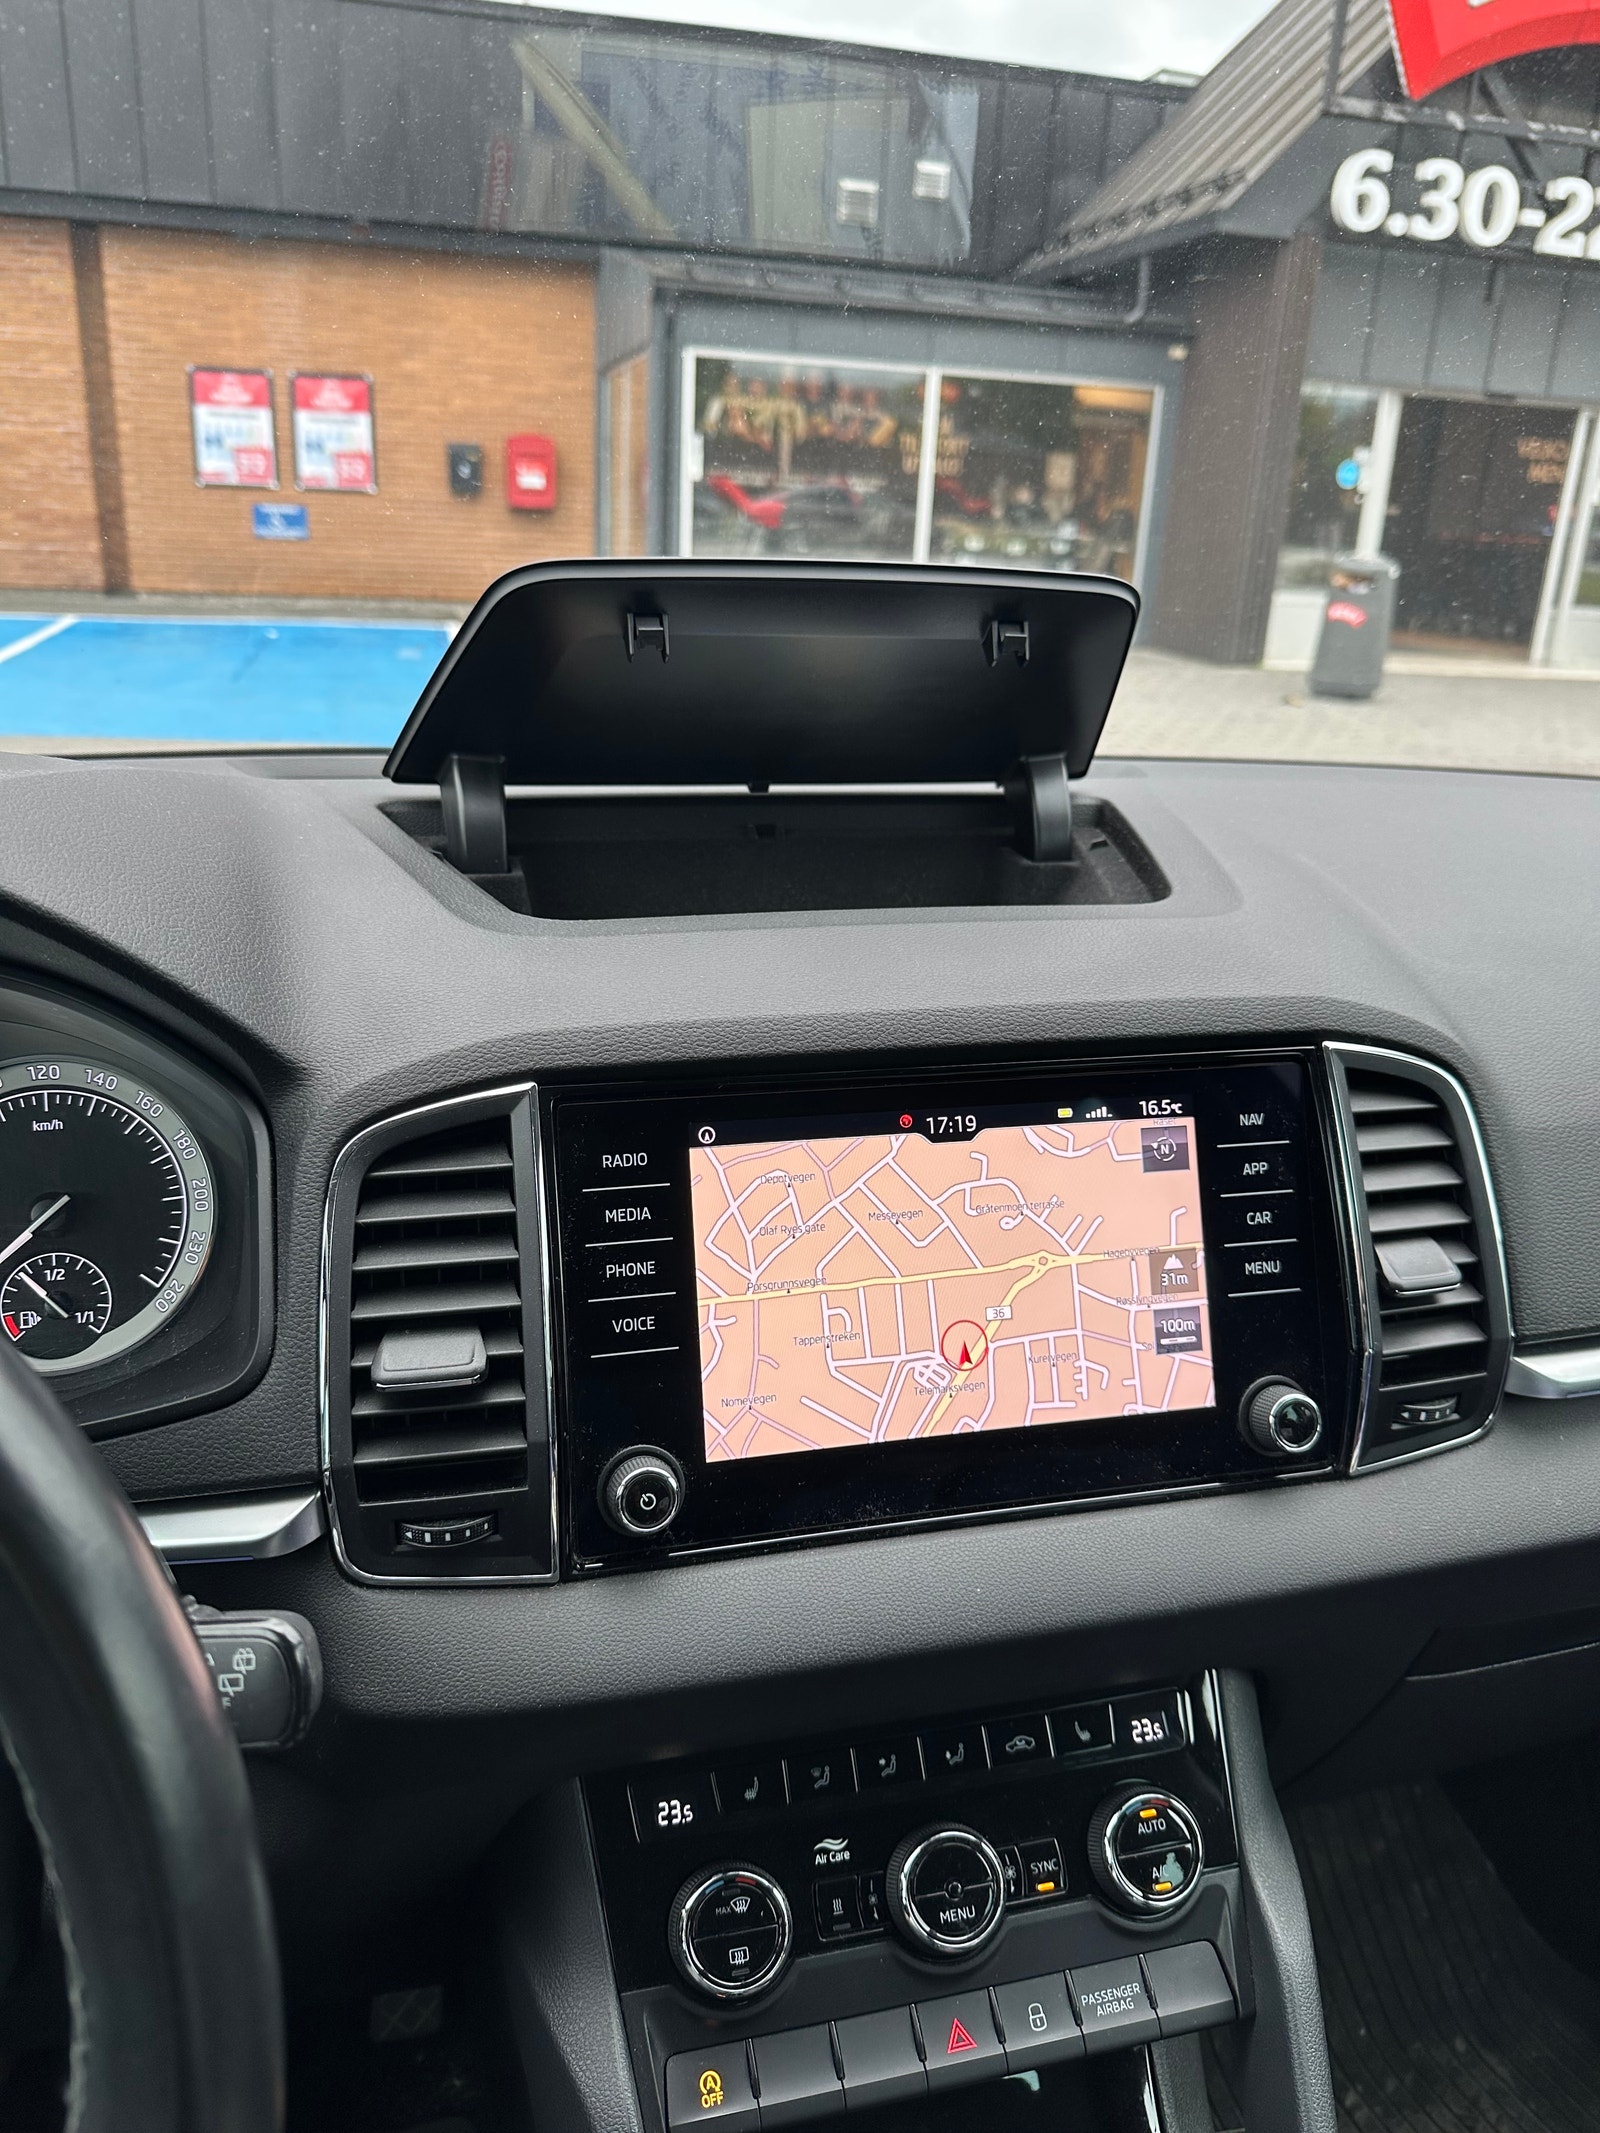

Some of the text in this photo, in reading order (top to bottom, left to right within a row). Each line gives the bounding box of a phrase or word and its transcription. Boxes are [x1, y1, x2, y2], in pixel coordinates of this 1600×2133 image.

[1330, 147, 1600, 262] 6.30-2
[26, 1065, 60, 1081] 120
[85, 1069, 118, 1090] 140
[135, 1090, 163, 1118] 160
[32, 1120, 64, 1132] km/h
[926, 1114, 977, 1135] 17:19
[1239, 1112, 1265, 1127] NAV
[171, 1129, 198, 1161] 180
[602, 1152, 648, 1168] RADIO
[1242, 1161, 1269, 1176] APP
[760, 1172, 816, 1185] Depotvegen
[190, 1177, 209, 1212] 200
[605, 1206, 652, 1224] MEDIA
[868, 1208, 924, 1222] Messevegen
[1246, 1211, 1273, 1226] CAR
[759, 1222, 826, 1237] Olaf Ryes gate
[185, 1230, 206, 1265] 230
[44, 1268, 66, 1282] 1/2
[606, 1260, 656, 1279] PHONE
[1245, 1260, 1282, 1275] MENU
[747, 1276, 827, 1292] Porsgrunnsvegen
[1160, 1271, 1189, 1287] 31m
[154, 1278, 185, 1313] 260
[74, 1310, 94, 1324] 1/1
[992, 1308, 1005, 1319] 36
[612, 1315, 656, 1334] VOICE
[1160, 1318, 1196, 1333] 100m
[793, 1330, 861, 1347] Tappenstreken
[721, 1392, 777, 1408] Nomevegen
[1131, 1717, 1163, 1743] 23.5
[657, 1799, 693, 1827] 23.5
[1137, 1818, 1167, 1835] AUTO
[814, 1849, 850, 1865] Air Care
[1030, 1858, 1059, 1875] SYNC
[715, 1904, 732, 1916] MAX
[939, 1905, 976, 1925] MENU
[1081, 1982, 1141, 2007] PASSENGER
[1096, 2000, 1135, 2018] AIRBAG
[701, 2090, 724, 2109] OFF
